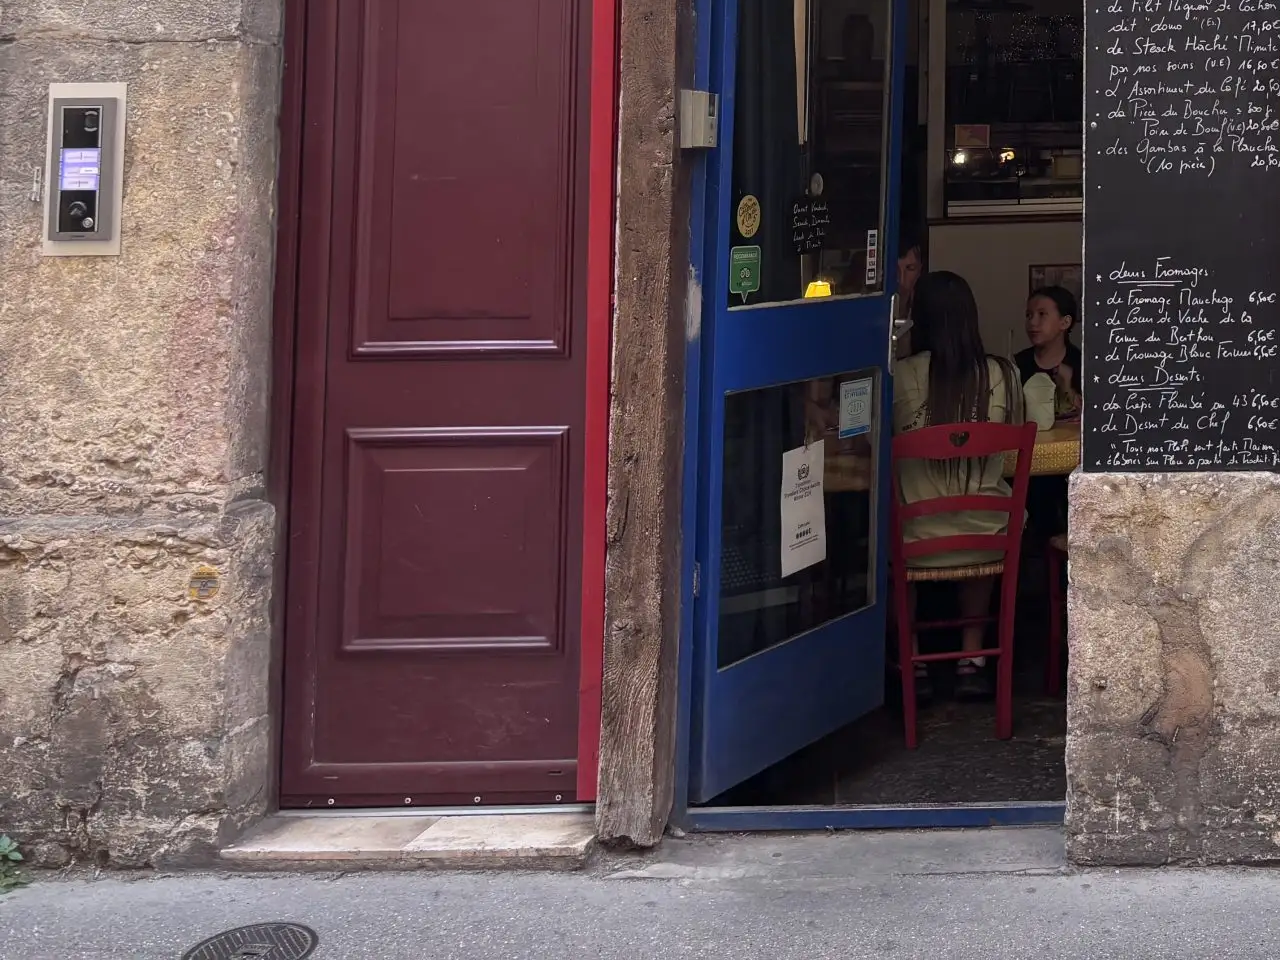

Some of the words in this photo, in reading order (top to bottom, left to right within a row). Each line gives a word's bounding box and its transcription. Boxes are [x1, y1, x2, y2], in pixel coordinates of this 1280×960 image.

[1108, 0, 1122, 12] Le
[1215, 0, 1231, 13] de
[1108, 19, 1136, 32] dit
[1242, 20, 1280, 35] 17,50€
[1107, 38, 1123, 55] Le
[1132, 37, 1176, 54] Steack
[1110, 65, 1128, 80] par
[1133, 65, 1156, 76] nos
[1167, 62, 1194, 71] soins
[1194, 85, 1216, 95] du
[1221, 76, 1246, 98] Café
[1108, 100, 1125, 118] La
[1162, 104, 1177, 116] du
[1184, 100, 1227, 118] Boucher
[1173, 122, 1188, 135] de
[1106, 138, 1127, 155] Les
[1136, 138, 1187, 163] Gambas
[1214, 137, 1224, 152] la
[1228, 135, 1279, 152] Plancha
[1107, 294, 1123, 304] Le
[1128, 289, 1171, 313] Fromage
[1180, 289, 1233, 313] Manchego
[1107, 310, 1120, 325] Le
[1157, 313, 1171, 323] de
[1178, 308, 1209, 324] Vache
[1219, 312, 1235, 323] de
[1241, 311, 1252, 324] la
[1109, 328, 1138, 344] Ferme
[1145, 331, 1160, 341] du
[1105, 347, 1119, 361] Le
[1126, 344, 1173, 368] Fromage
[1176, 345, 1210, 362] Blanc
[1103, 394, 1121, 411] La
[1126, 393, 1151, 413] Crêpe
[1210, 402, 1225, 411] au
[1233, 395, 1247, 408] 43
[1101, 413, 1117, 432] Le
[1119, 413, 1169, 436] Dessert
[1171, 418, 1189, 430] du
[1197, 412, 1230, 434] Chef
